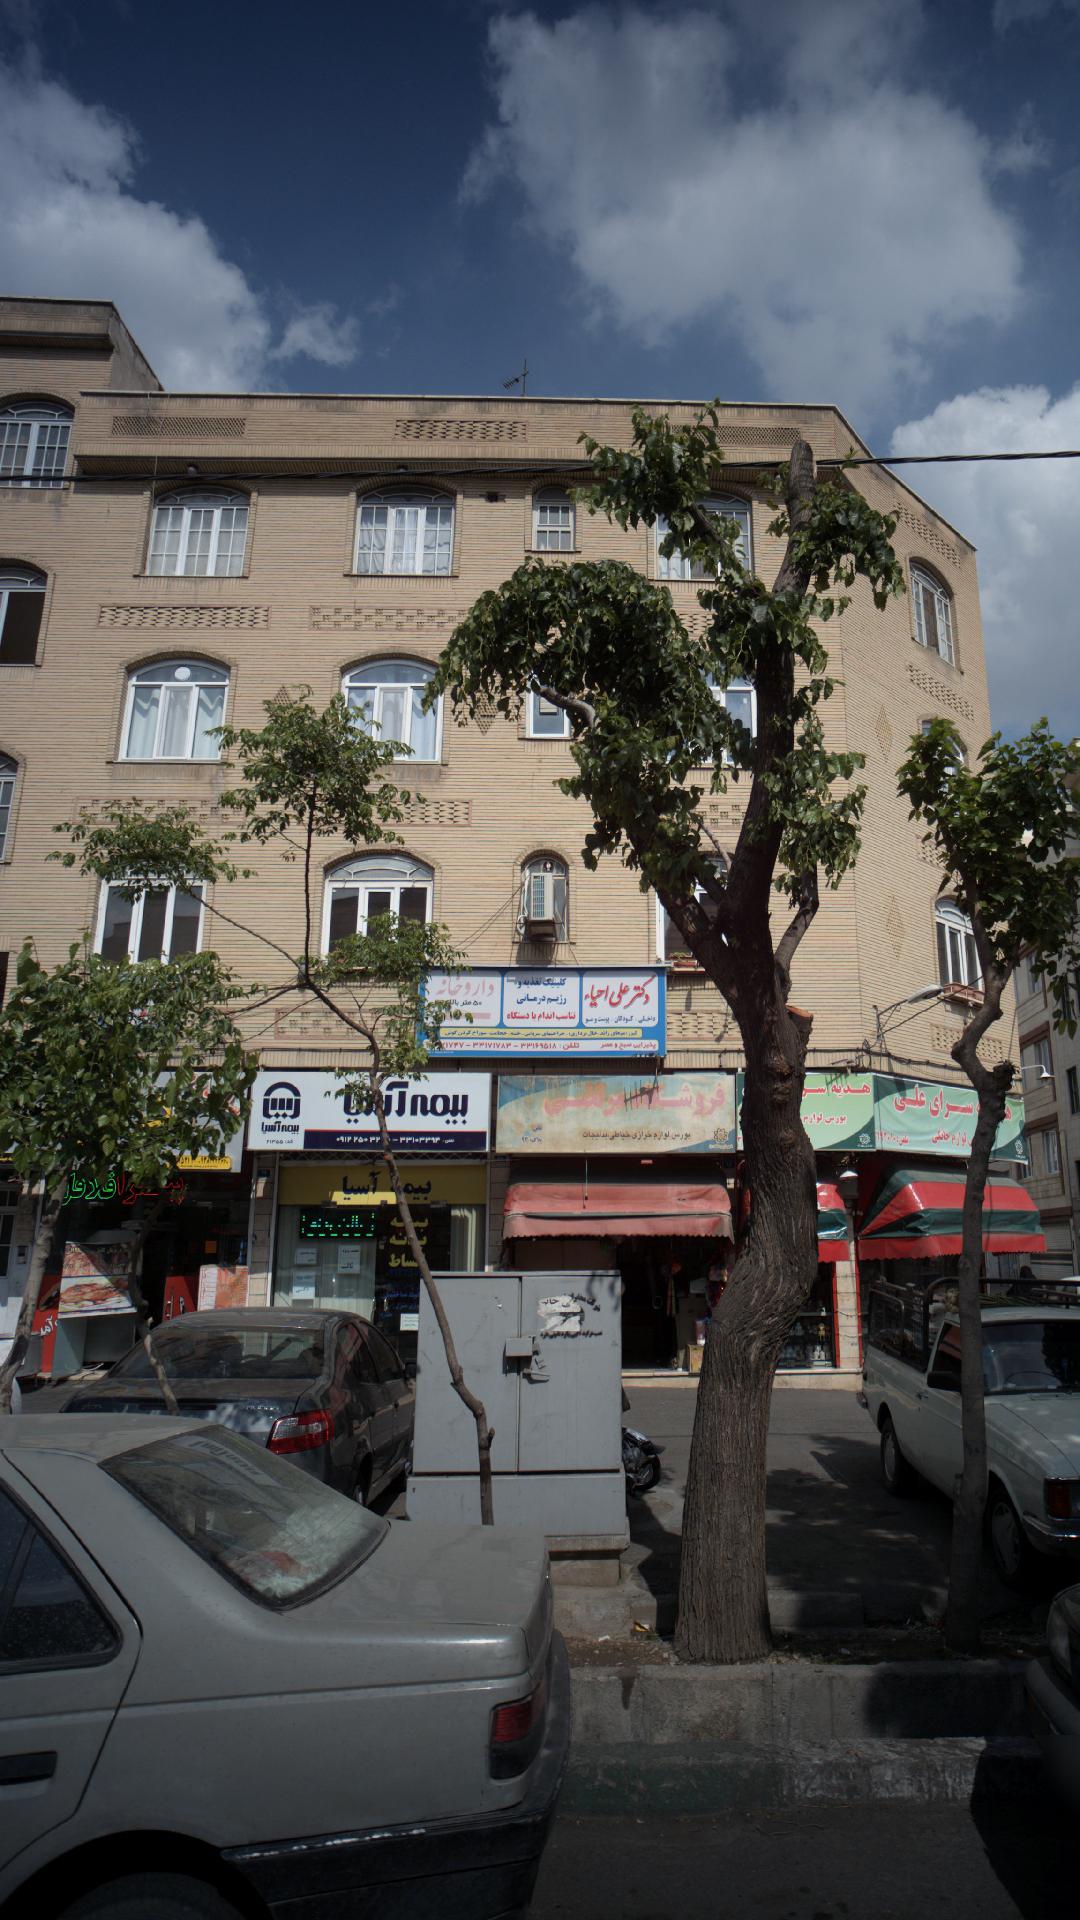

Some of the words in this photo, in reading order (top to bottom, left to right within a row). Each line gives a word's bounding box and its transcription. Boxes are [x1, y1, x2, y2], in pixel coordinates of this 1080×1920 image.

[435, 976, 495, 997] داروخانه
[522, 977, 541, 988] تغذیه
[542, 977, 567, 989] کلینیک
[608, 982, 630, 1008] علی
[623, 974, 657, 1009] دکتر
[516, 994, 546, 1005] درمانی
[546, 994, 567, 1005] رژیم
[506, 1011, 530, 1020] دستگاه
[531, 1011, 537, 1020] با
[537, 1011, 555, 1021] اندام
[555, 1011, 576, 1019] تناسب
[893, 1083, 926, 1112] علی
[409, 1094, 469, 1125] بیمه
[342, 1171, 381, 1201] آسیا
